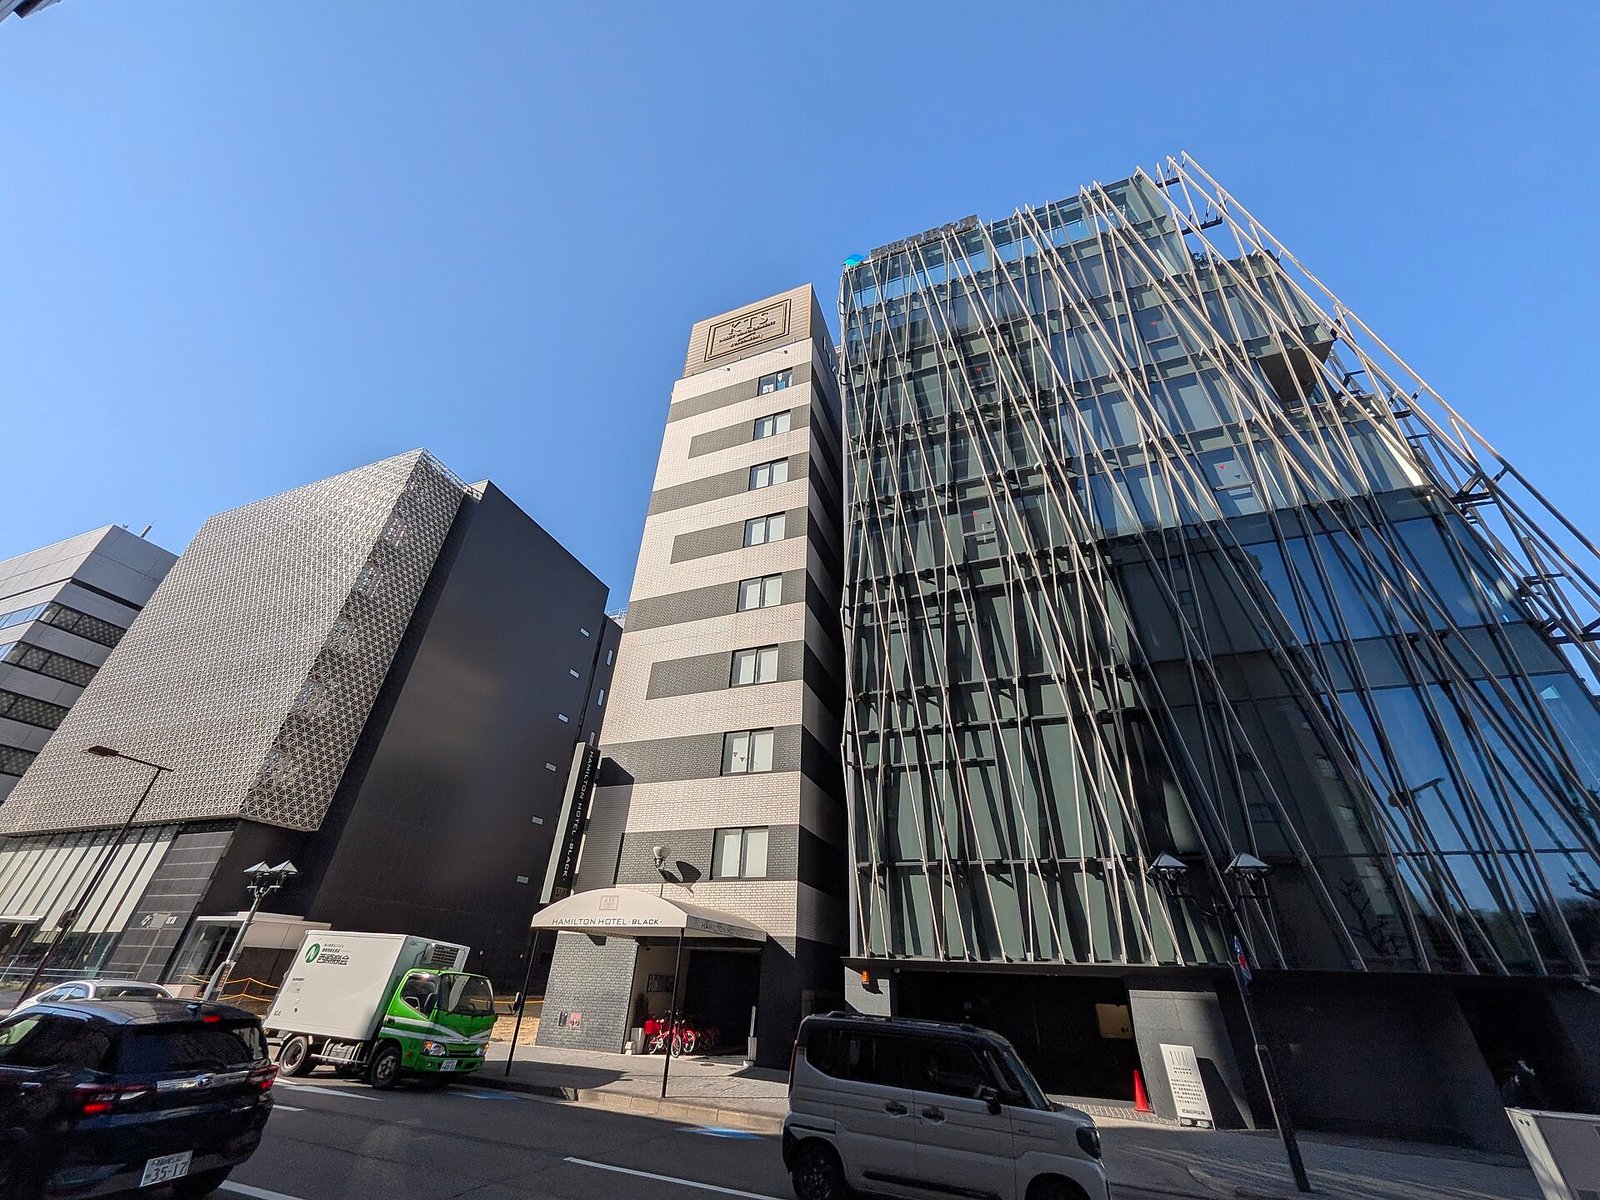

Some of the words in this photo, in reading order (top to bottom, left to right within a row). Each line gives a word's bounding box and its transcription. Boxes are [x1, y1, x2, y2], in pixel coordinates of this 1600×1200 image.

[728, 312, 769, 335] KTS
[579, 750, 594, 800] HAMILTON
[571, 802, 583, 835] HOTEL
[551, 917, 596, 926] HAMILTON
[597, 917, 628, 926] HOTEL
[152, 1162, 188, 1181] 35-17
